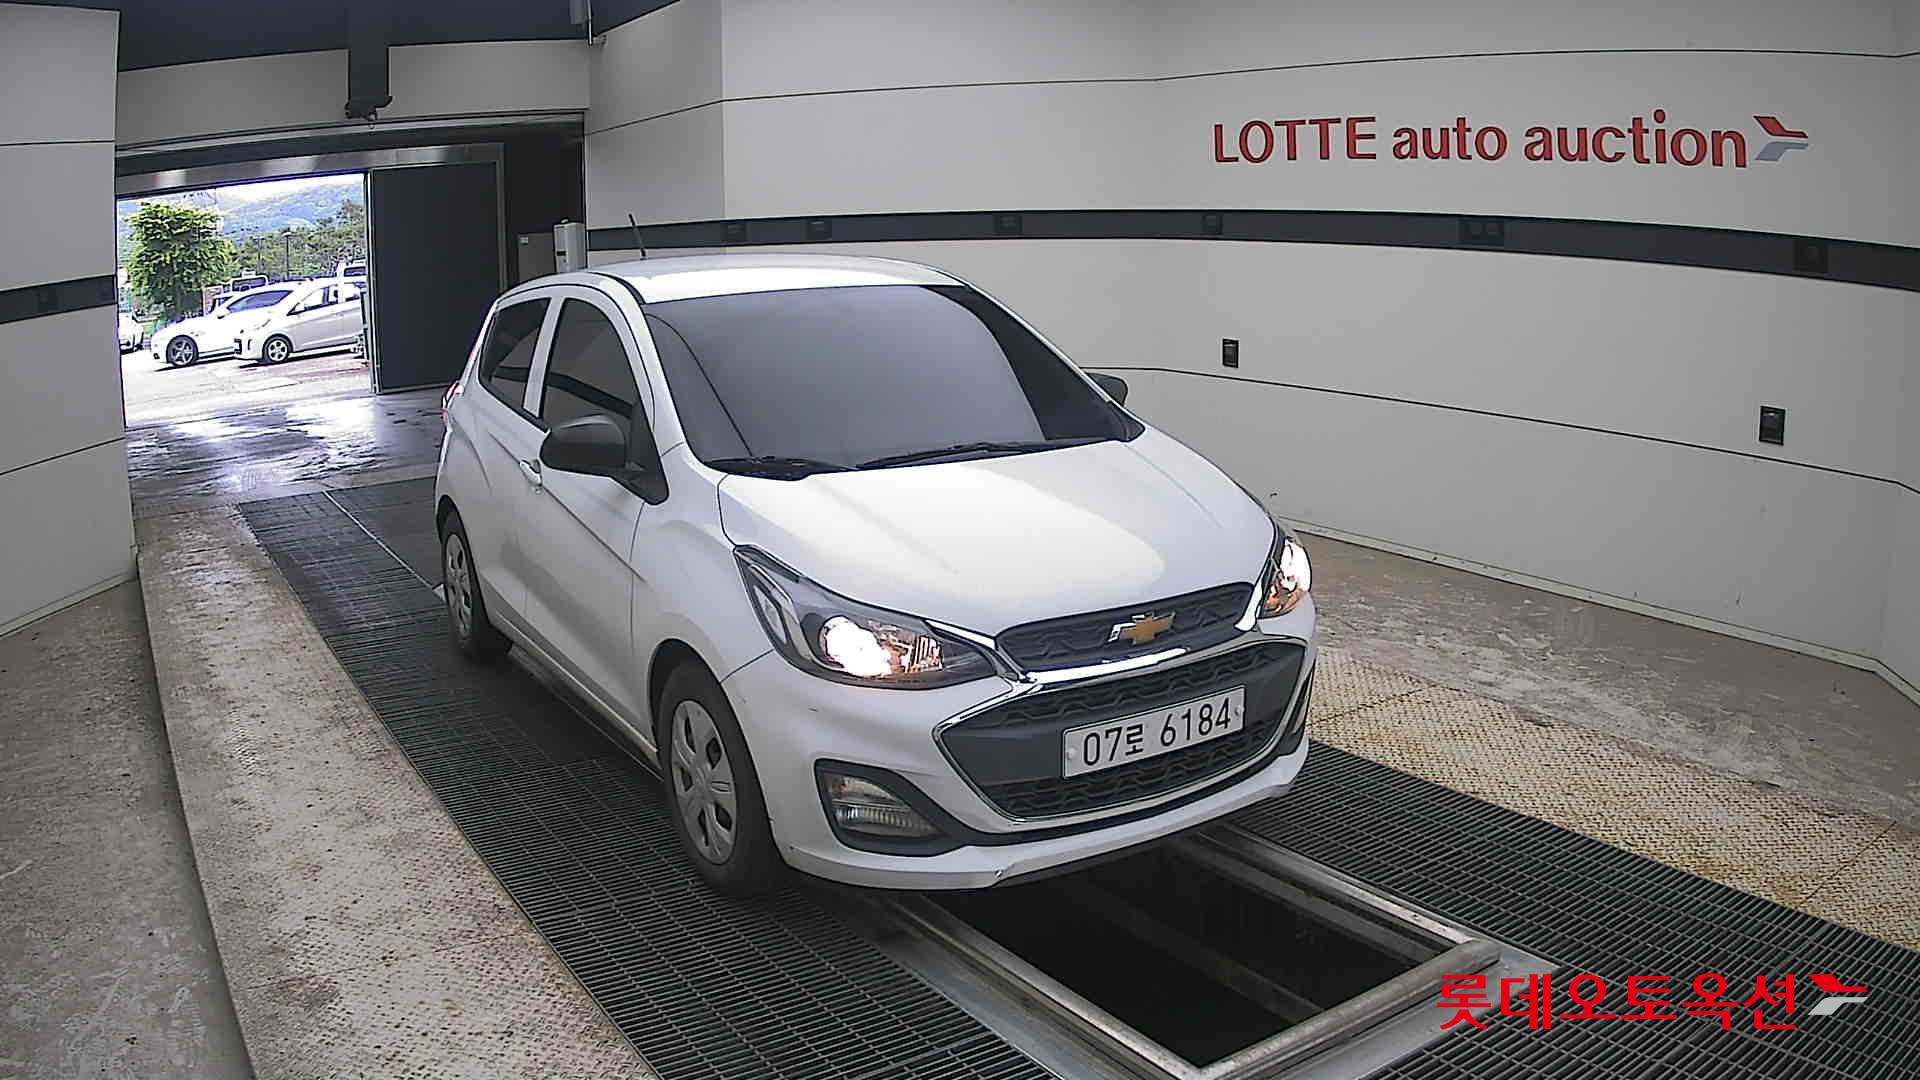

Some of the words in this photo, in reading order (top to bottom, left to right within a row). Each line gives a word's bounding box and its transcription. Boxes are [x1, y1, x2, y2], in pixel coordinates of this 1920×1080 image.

[1213, 116, 1377, 164] LOTTE
[1392, 117, 1508, 162] auto
[1523, 109, 1748, 169] auction
[1083, 723, 1144, 767] 07로
[1160, 697, 1231, 747] 6184
